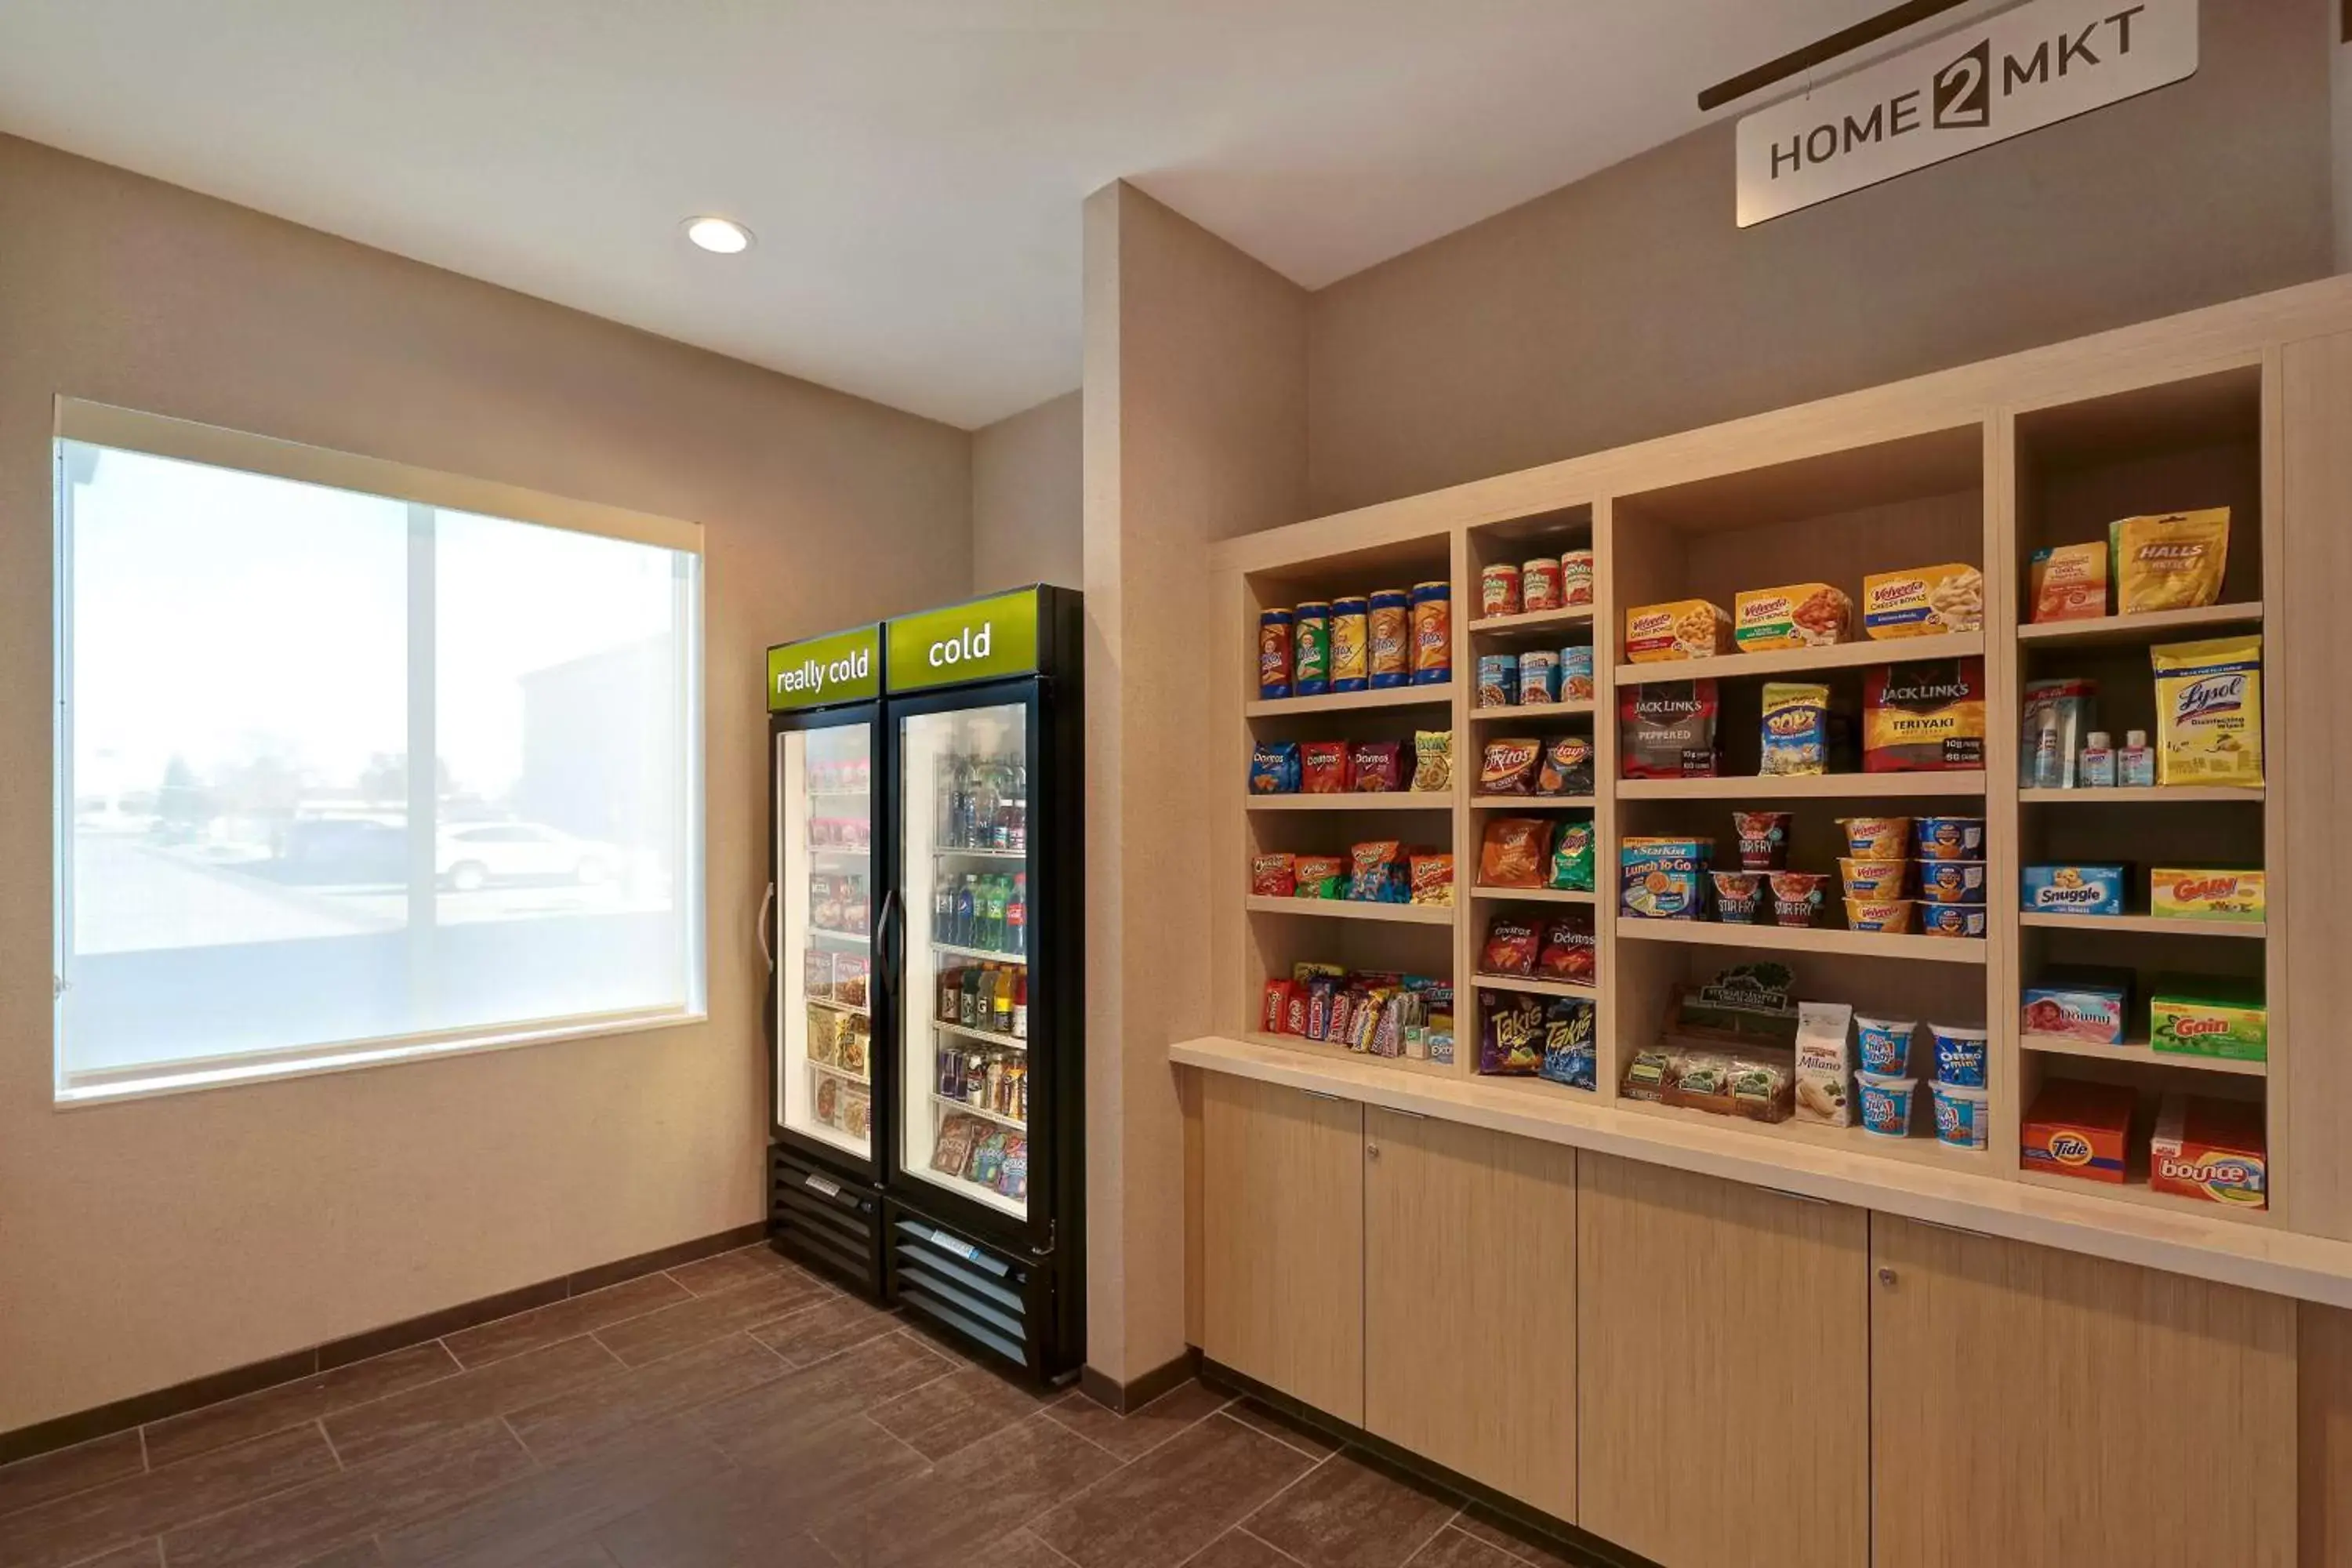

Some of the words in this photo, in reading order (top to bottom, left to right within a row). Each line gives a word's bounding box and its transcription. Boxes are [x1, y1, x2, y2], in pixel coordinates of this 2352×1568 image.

[1771, 90, 1920, 180] HOME
[1936, 53, 1985, 125] 2
[2002, 4, 2145, 96] MKT
[2139, 544, 2204, 559] HALLS
[928, 622, 992, 667] cold
[777, 660, 826, 694] really
[829, 648, 869, 683] cold
[1879, 687, 1918, 703] JACK
[2180, 677, 2241, 710] Lysol
[1635, 702, 1663, 713] JACK
[1892, 717, 1955, 731] TERIYAKI
[1755, 840, 1773, 853] FRY
[1625, 860, 1657, 877] Lunch
[1674, 858, 1692, 871] Go
[2042, 887, 2100, 903] Snuggle
[1719, 899, 1737, 912] STIR
[1738, 900, 1755, 913] FRY
[1795, 902, 1813, 916] FRY
[1552, 931, 1595, 945] Doritos
[2060, 1009, 2111, 1025] Downy
[1491, 1004, 1542, 1048] Takis
[1546, 1011, 1593, 1054] Takis
[2175, 1017, 2230, 1036] Gain
[1797, 1055, 1842, 1072] Milano
[2053, 1140, 2088, 1157] Tide
[2161, 1158, 2245, 1182] bounce
